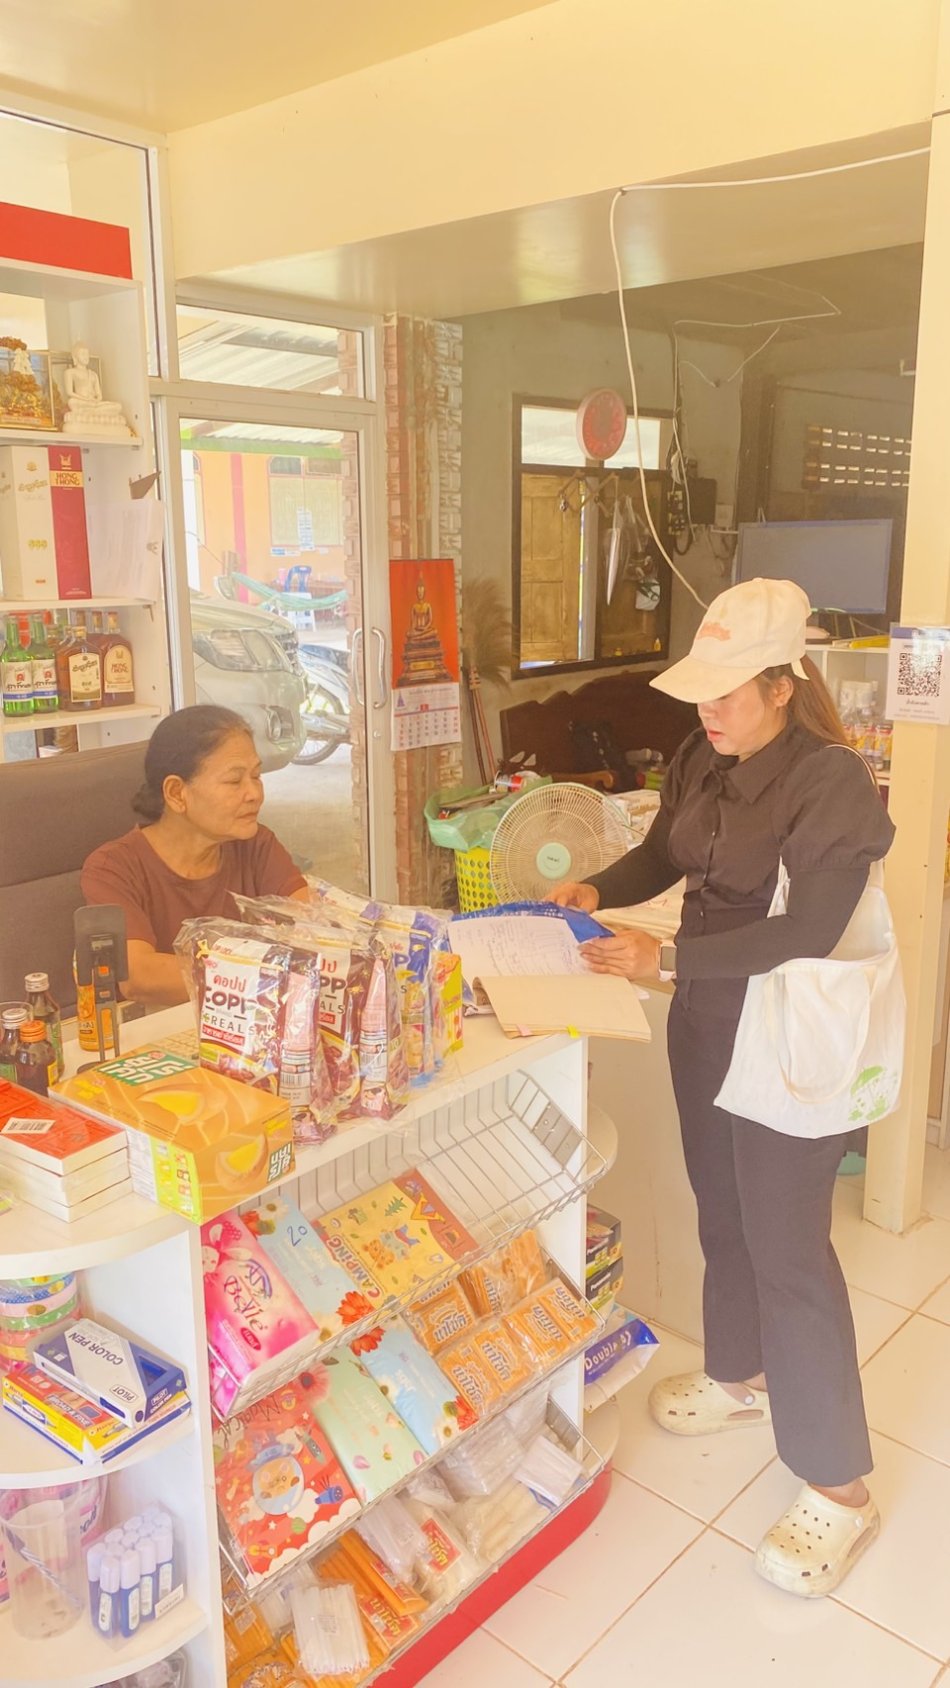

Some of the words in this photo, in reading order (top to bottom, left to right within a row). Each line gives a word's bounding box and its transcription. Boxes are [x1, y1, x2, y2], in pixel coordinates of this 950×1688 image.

[55, 478, 80, 486] THONG
[56, 472, 78, 480] HONG
[319, 976, 347, 995] PP
[287, 1225, 308, 1247] 20
[68, 1332, 90, 1347] PEN
[88, 1340, 124, 1366] COLOR
[112, 1386, 135, 1401] PILOT
